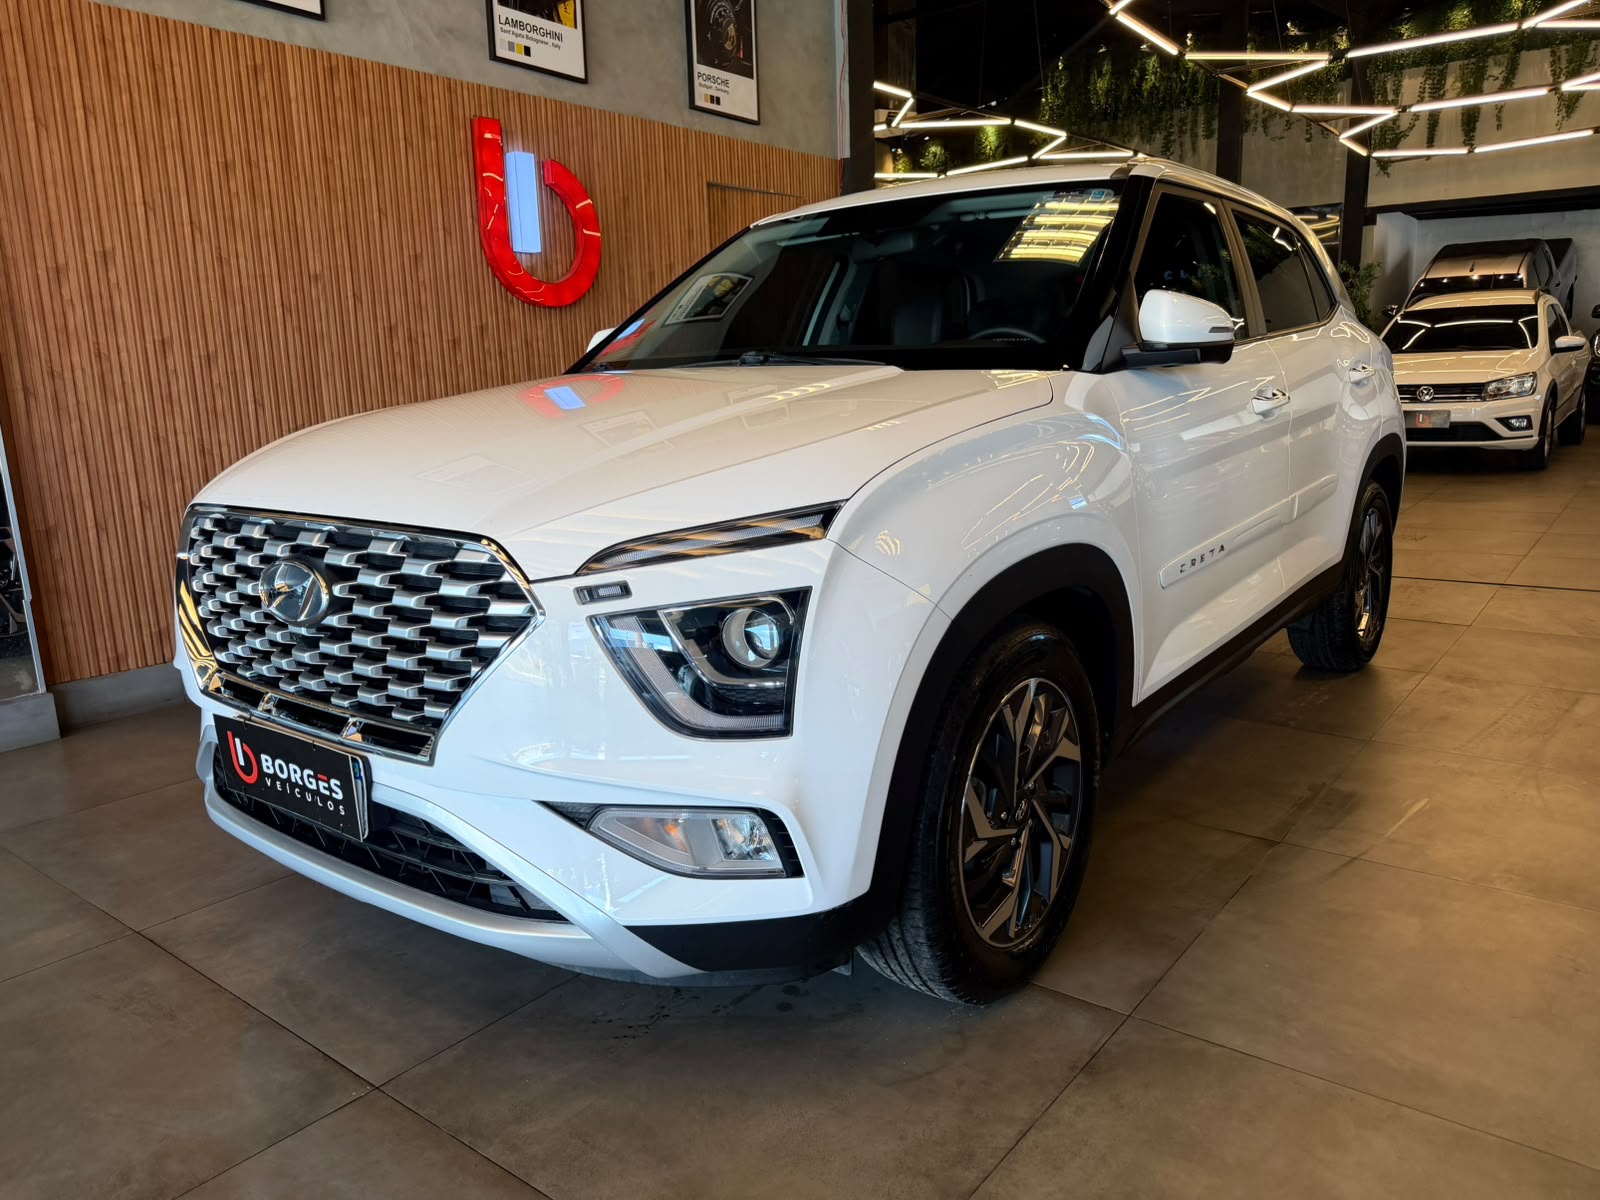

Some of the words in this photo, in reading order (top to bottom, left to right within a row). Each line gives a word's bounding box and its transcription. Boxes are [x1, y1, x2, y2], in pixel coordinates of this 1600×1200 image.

[498, 14, 563, 42] LAMBORGHINI
[697, 71, 730, 88] PORSCHE
[1180, 544, 1225, 573] CRETA
[260, 753, 344, 800] BORGES
